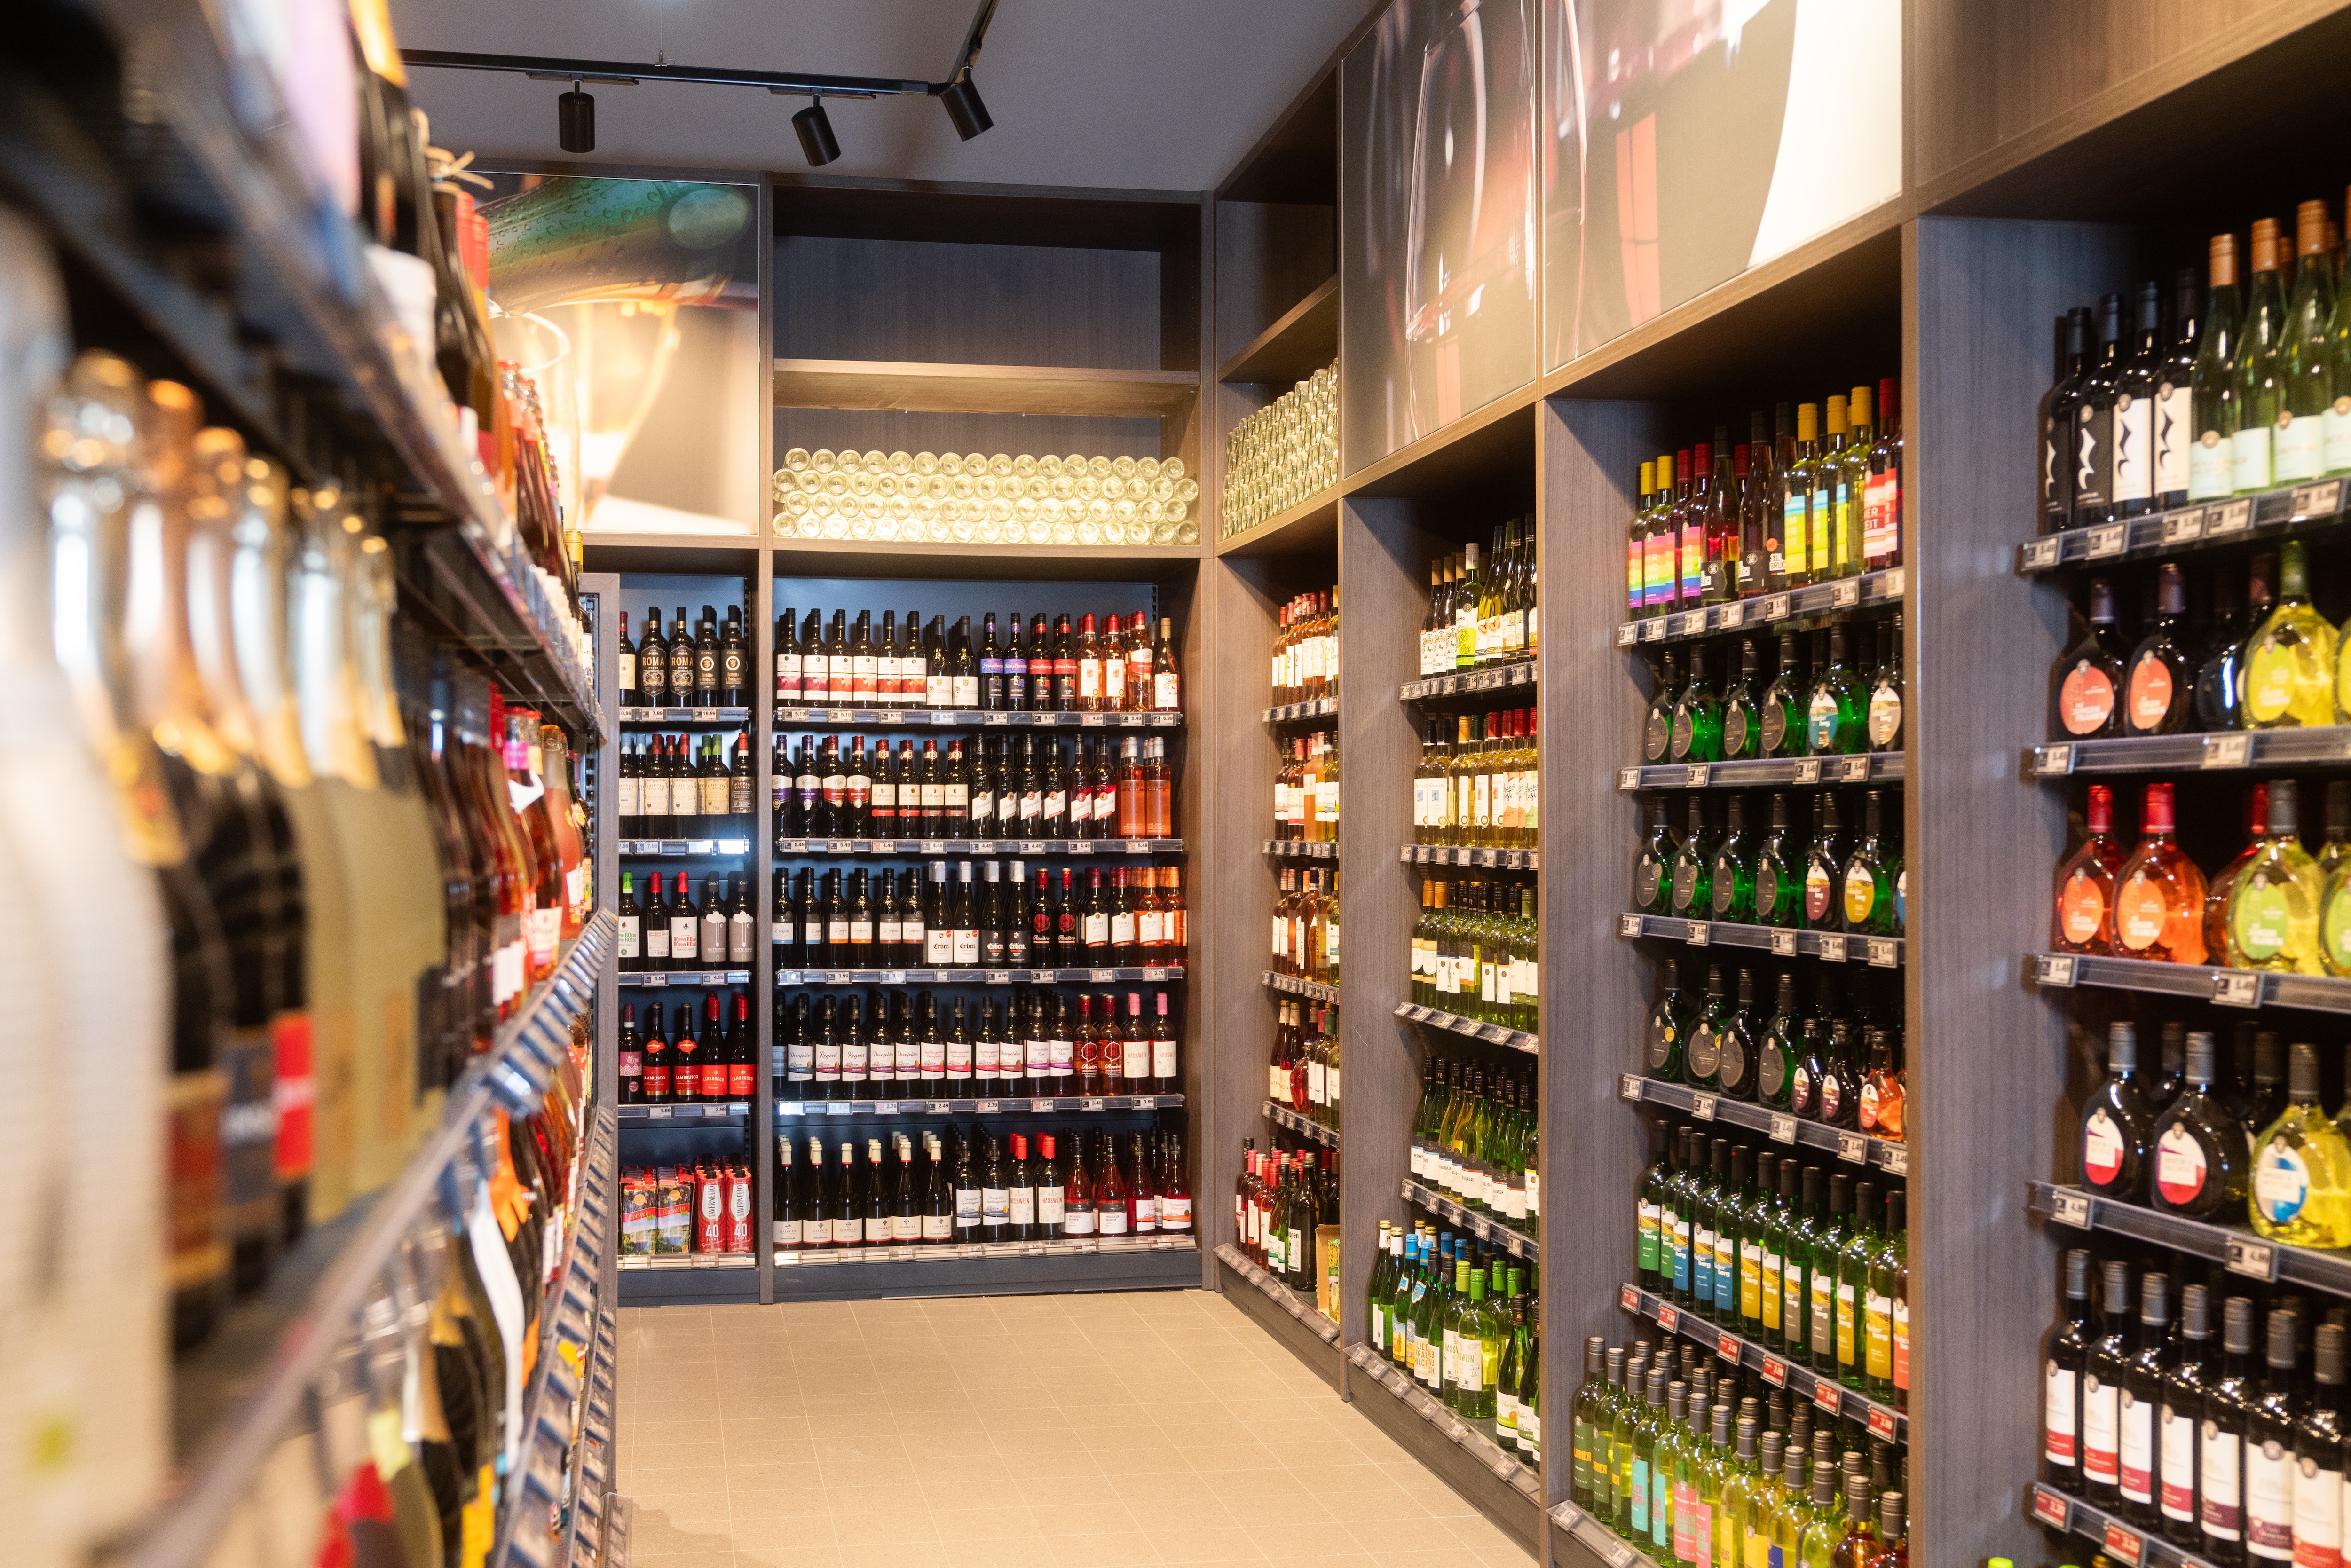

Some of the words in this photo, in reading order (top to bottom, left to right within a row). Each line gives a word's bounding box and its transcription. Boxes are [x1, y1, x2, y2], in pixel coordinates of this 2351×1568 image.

[642, 657, 665, 666] ROMA
[671, 657, 693, 666] ROMA
[820, 1051, 838, 1059] Regent
[847, 1051, 865, 1059] Regent
[628, 1210, 651, 1220] Rotwein
[663, 1207, 686, 1215] Rotwein
[706, 1224, 719, 1237] 40
[734, 1223, 747, 1237] 40
[1745, 1276, 1758, 1285] berg
[1417, 1342, 1428, 1351] LIEB
[1728, 1343, 1738, 1352] 3.99
